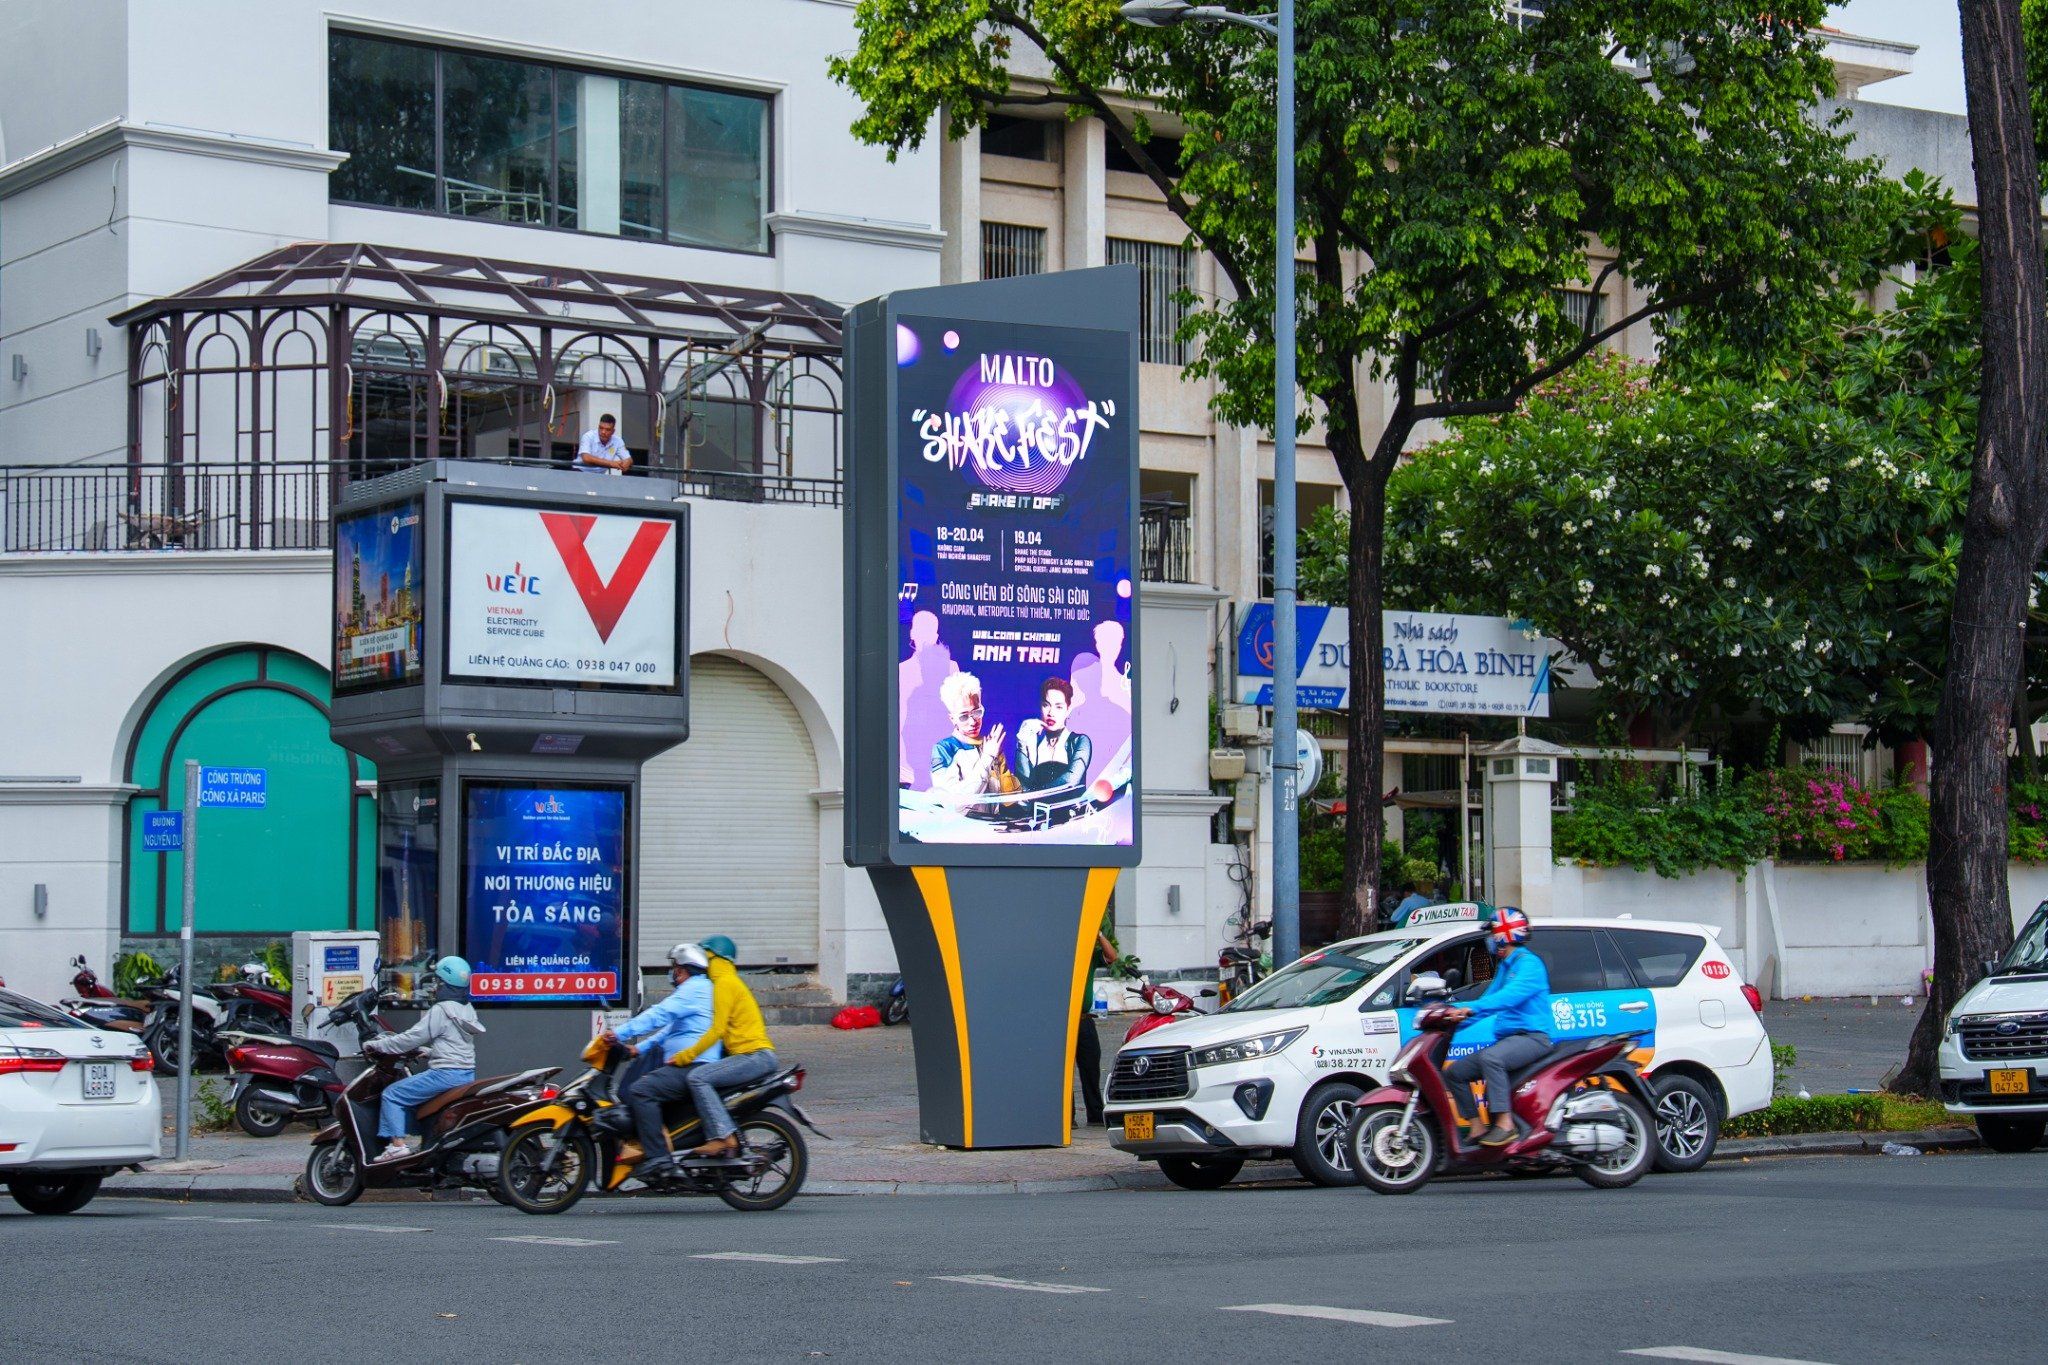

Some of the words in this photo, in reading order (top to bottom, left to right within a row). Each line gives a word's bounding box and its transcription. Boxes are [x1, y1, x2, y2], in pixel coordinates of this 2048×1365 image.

[980, 353, 1054, 387] MALTO
[971, 493, 1016, 508] SHAKE
[1018, 496, 1031, 508] IT
[1033, 497, 1061, 510] OFF
[937, 527, 984, 542] 18-20.04
[1014, 531, 1042, 545] 19.04
[942, 581, 971, 600] CÔNG
[973, 582, 997, 602] VIÊN
[1000, 583, 1015, 602] BỜ
[1017, 585, 1045, 603] SÔNG
[1048, 586, 1064, 605] SÀI
[1068, 587, 1090, 606] GÒN
[487, 606, 523, 615] VIETNAM
[977, 605, 1015, 618] METROPOLE
[1054, 608, 1062, 620] TP
[487, 617, 538, 627] ELECTRICITY
[1393, 614, 1425, 642] Nhà
[1428, 617, 1459, 644] sách
[487, 627, 521, 636] SERVICE
[523, 628, 545, 637] CUBE
[972, 630, 1022, 641] WELCOME
[972, 644, 1012, 663] ANH
[1017, 646, 1061, 664] TRAI
[1417, 645, 1468, 674] HÒA
[1475, 647, 1537, 677] BÌNH
[469, 653, 490, 665] LIÊN
[493, 655, 505, 668] HỆ
[507, 655, 543, 669] QUẢNG
[545, 656, 570, 669] CÁO:
[577, 659, 605, 670] 0938
[609, 661, 630, 671] 047
[635, 662, 656, 673] 000
[1425, 681, 1479, 693] BOOKSTORE
[208, 770, 229, 784] CÔNG
[230, 770, 261, 785] TRƯỜNG
[202, 788, 226, 803] CÔNG
[227, 788, 239, 803] XÃ
[240, 791, 266, 804] PARIS
[1284, 788, 1295, 799] 19
[1284, 800, 1295, 811] 20
[496, 845, 511, 863] VỊ
[515, 843, 538, 861] TRÍ
[542, 841, 572, 861] ĐẮC
[576, 846, 601, 864] ĐỊA
[484, 875, 510, 891] NƠI
[514, 875, 575, 891] THƯƠNG
[580, 873, 612, 894] HIỆU
[492, 900, 535, 923] TỎA
[545, 902, 601, 923] SÁNG
[1424, 907, 1460, 920] VINASUN
[1460, 906, 1476, 918] TAXI
[506, 956, 525, 966] LIÊN
[527, 955, 538, 967] HỆ
[540, 955, 570, 967] QUẢNG
[572, 954, 590, 966] CÁO
[479, 978, 525, 990] 0938
[534, 978, 566, 990] 047
[575, 977, 608, 989] 000
[1576, 1009, 1607, 1028] 315
[1361, 1060, 1373, 1068] 27
[1375, 1060, 1387, 1068] 27
[92, 1065, 108, 1080] 60A
[2000, 1072, 2016, 1082] 50F
[1995, 1082, 2024, 1092] 047.92
